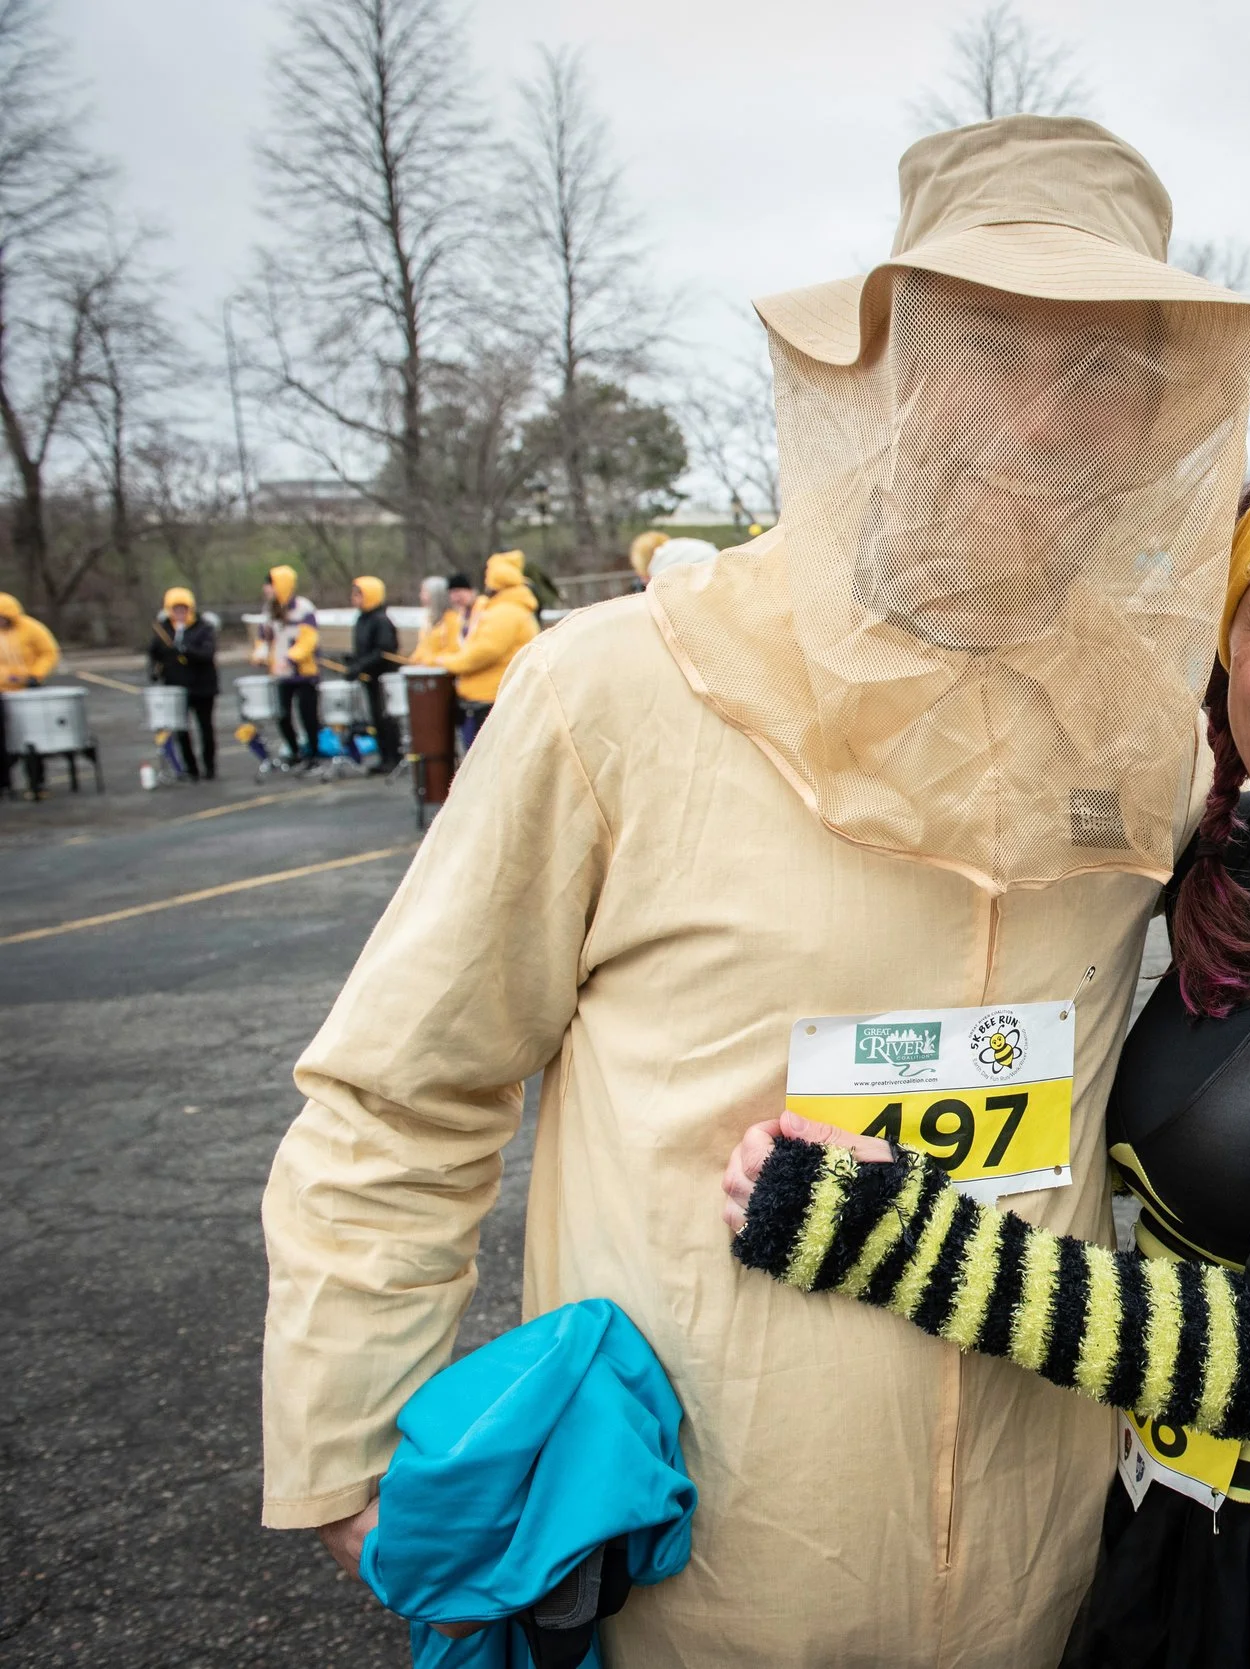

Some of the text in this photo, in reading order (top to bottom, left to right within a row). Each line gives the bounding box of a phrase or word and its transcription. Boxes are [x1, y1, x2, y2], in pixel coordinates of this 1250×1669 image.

[863, 1027, 892, 1036] GREAT
[970, 1015, 1019, 1050] 5K BEE RUN
[859, 1036, 930, 1061] RIVER
[854, 1078, 938, 1087] www.greatrivercoalition.com
